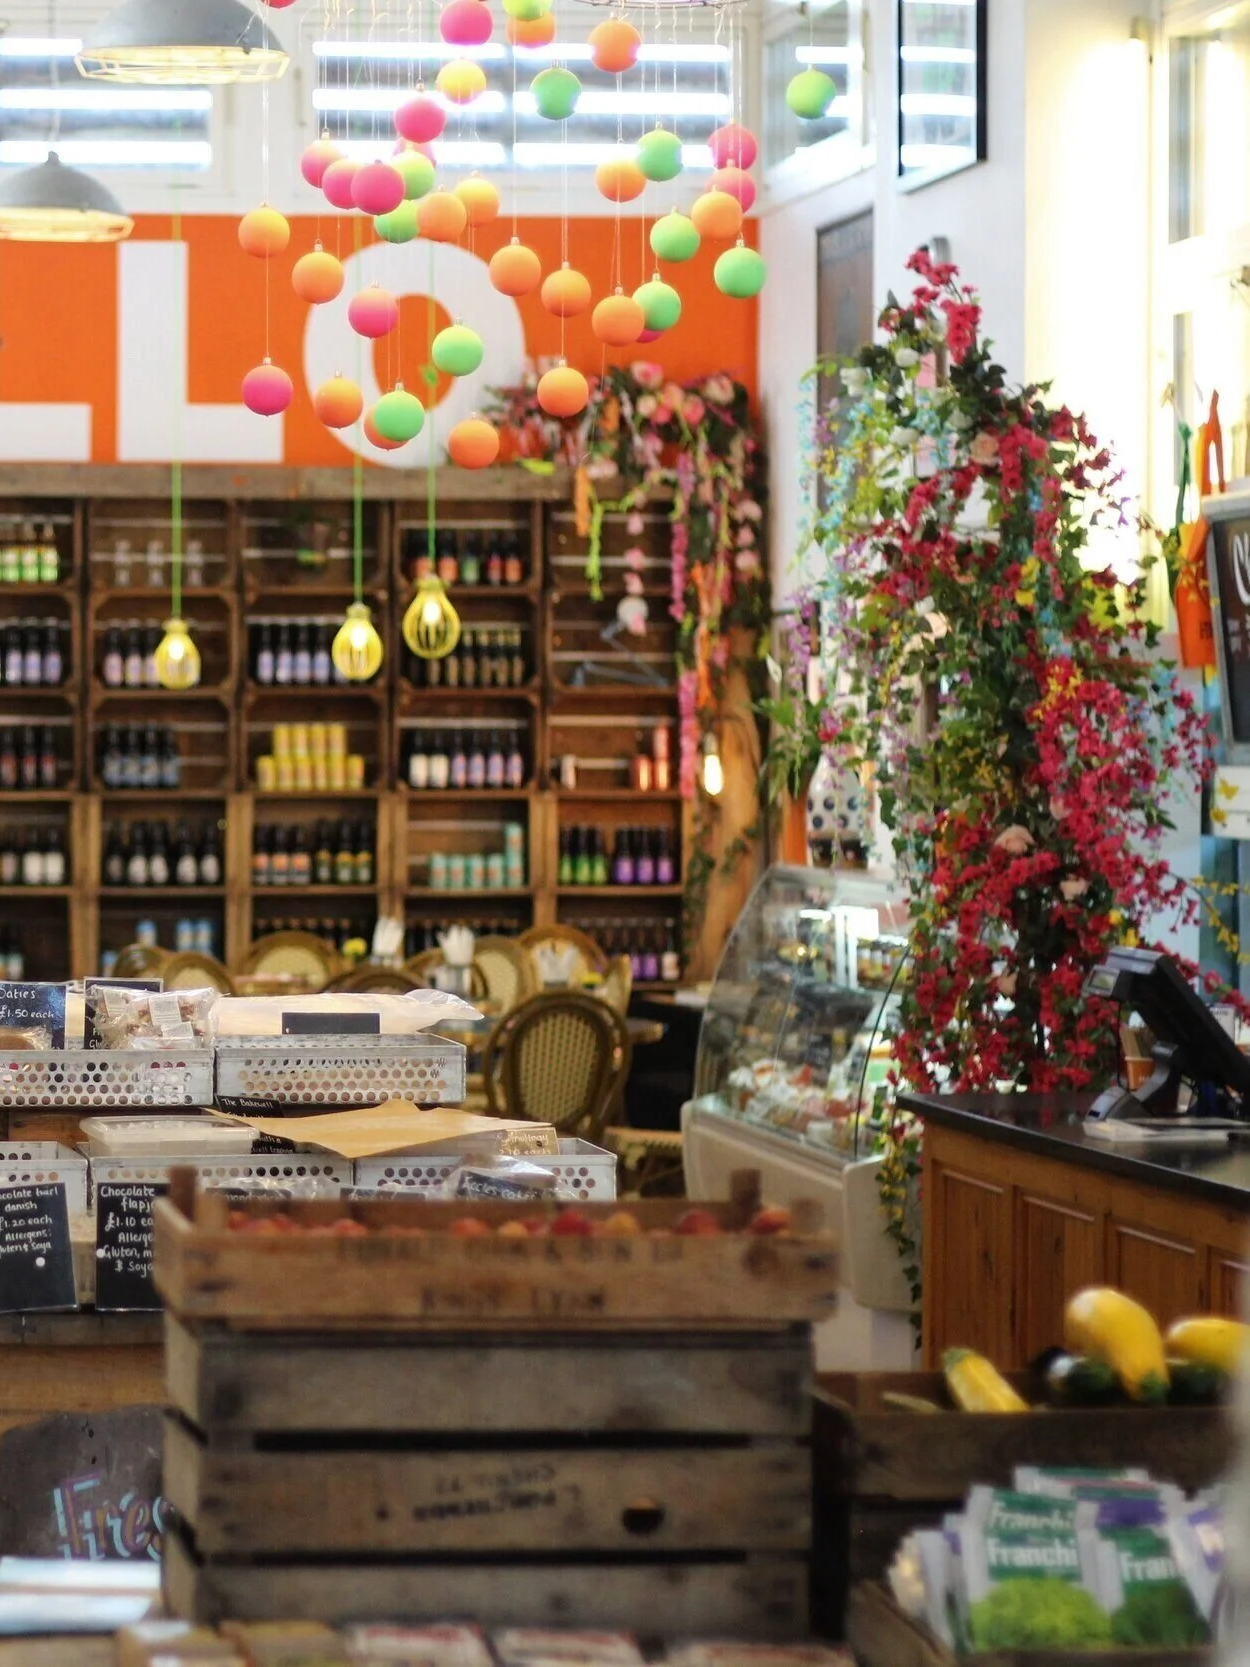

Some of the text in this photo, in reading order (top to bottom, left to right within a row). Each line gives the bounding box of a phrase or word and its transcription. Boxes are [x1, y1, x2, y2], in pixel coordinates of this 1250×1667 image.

[30, 1009, 54, 1019] each
[221, 1098, 273, 1109] The Bakewell
[100, 1185, 155, 1197] Chocolate
[4, 1201, 37, 1213] danish
[28, 1214, 53, 1225] each
[104, 1212, 136, 1232] £1.10
[986, 1537, 1079, 1567] Franchi
